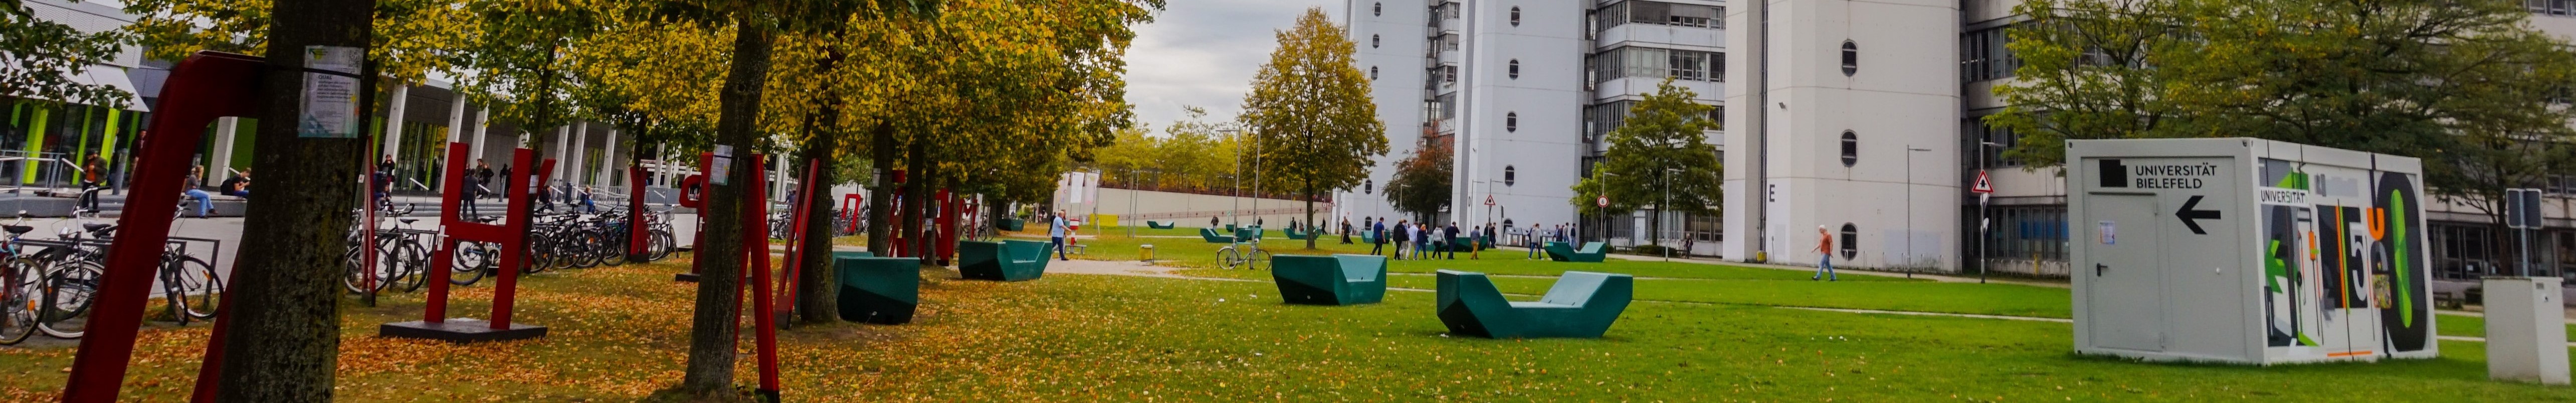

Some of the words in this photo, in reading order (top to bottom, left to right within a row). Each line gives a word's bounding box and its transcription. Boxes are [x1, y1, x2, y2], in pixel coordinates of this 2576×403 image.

[2136, 162, 2217, 176] UNIVERSITÄT
[2136, 178, 2202, 189] BIELEFELD
[1769, 184, 1775, 202] E
